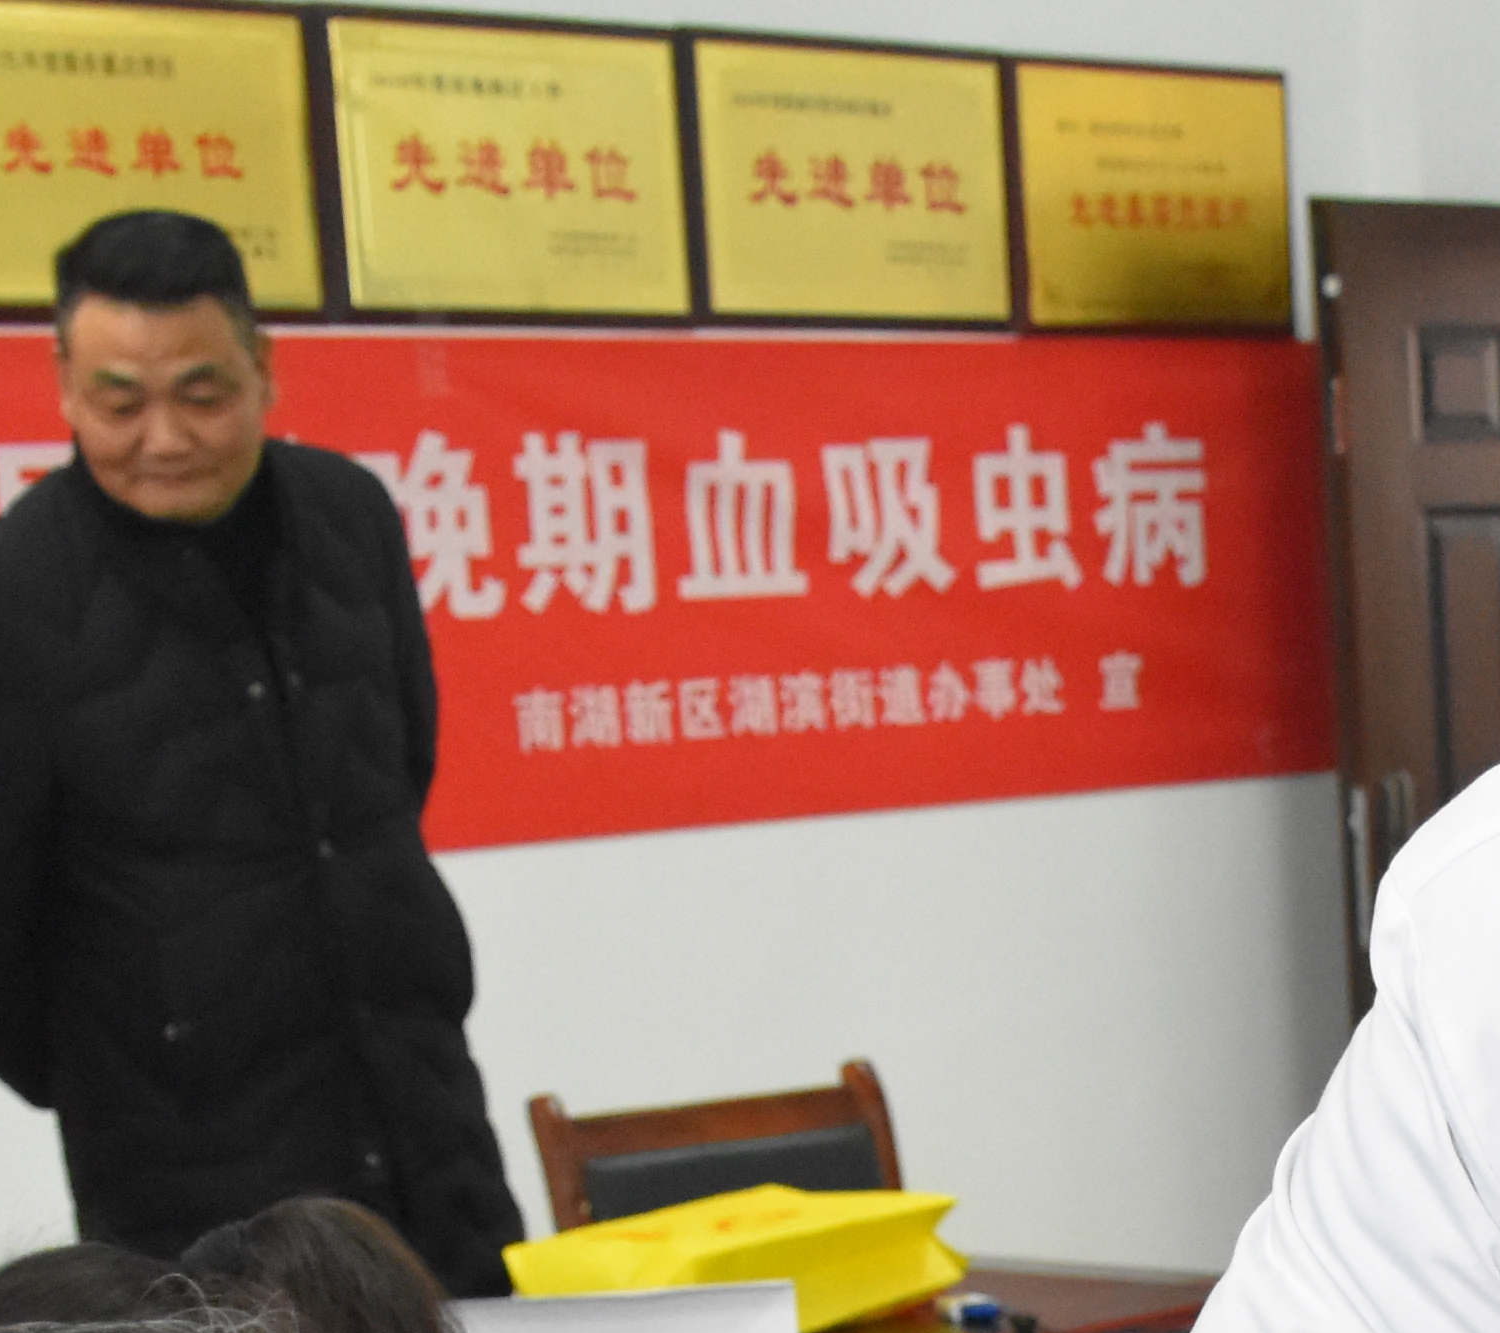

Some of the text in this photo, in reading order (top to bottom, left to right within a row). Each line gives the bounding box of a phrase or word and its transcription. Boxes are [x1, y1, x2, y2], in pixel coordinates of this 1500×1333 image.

[2, 120, 245, 181] 先进单位
[392, 132, 638, 201] 先进单位
[750, 147, 966, 213] 先进单位
[513, 651, 1142, 753] 南湖新区湖滨街道办事处 宣
